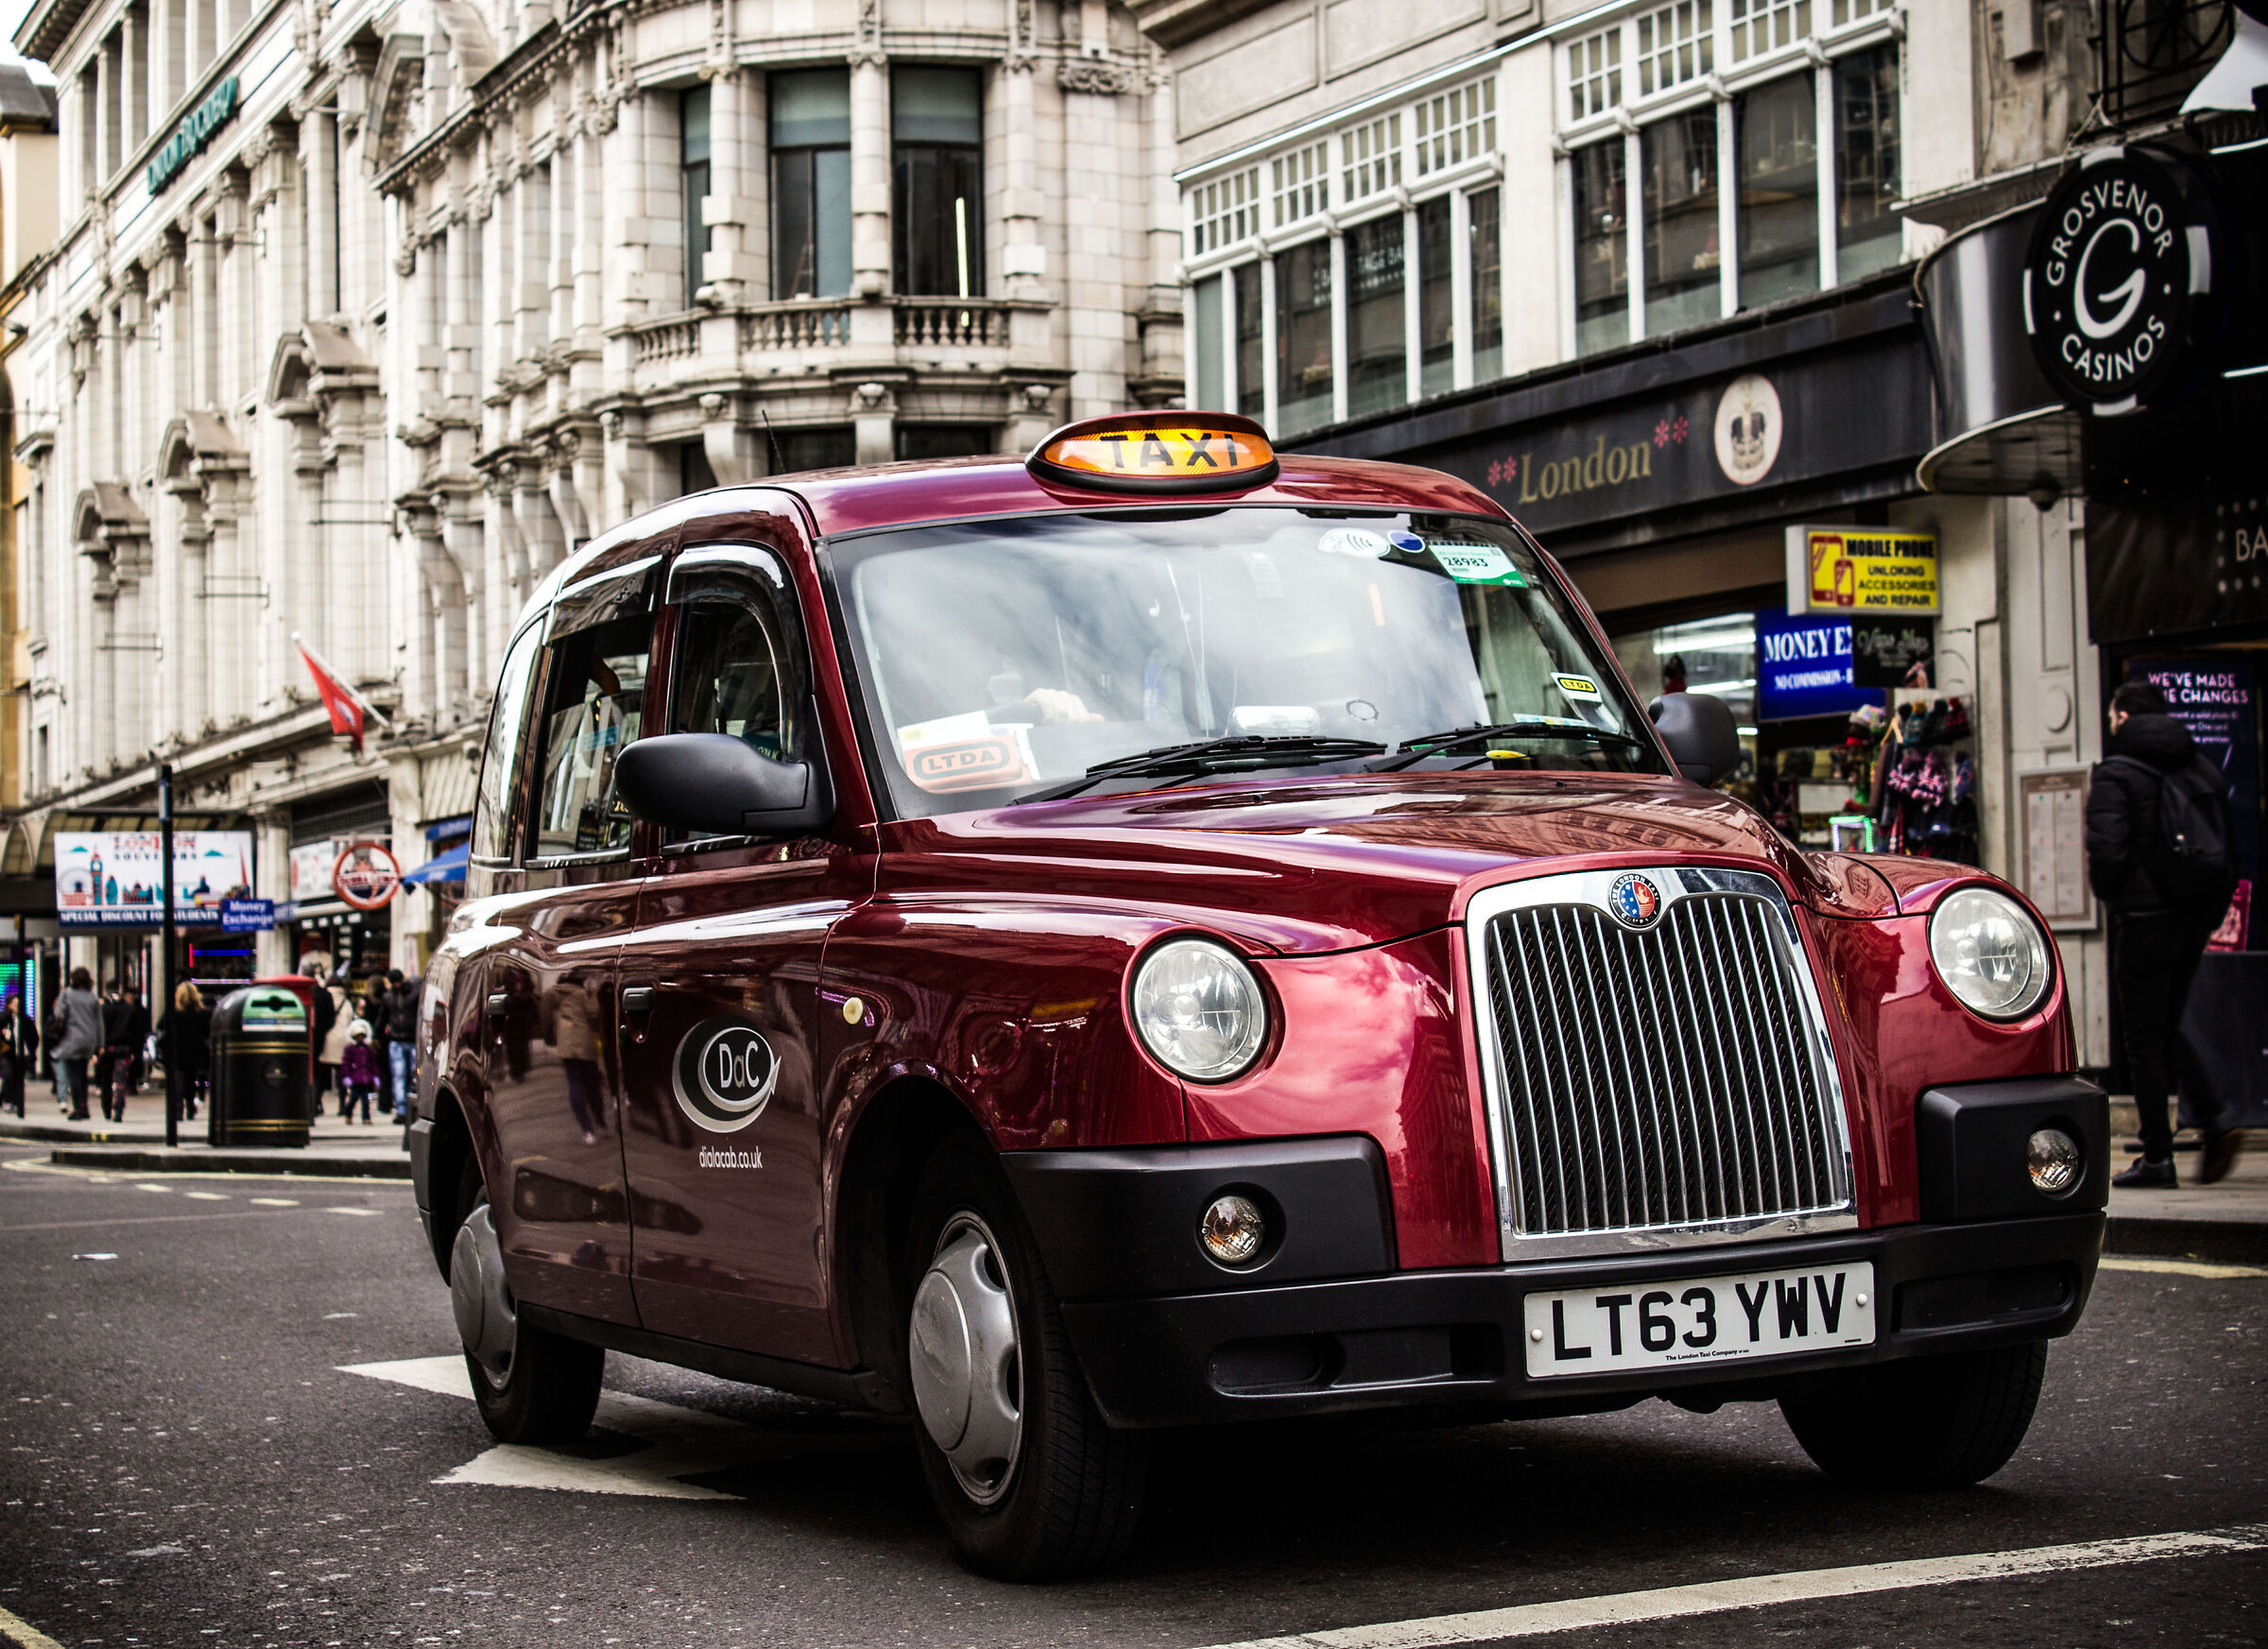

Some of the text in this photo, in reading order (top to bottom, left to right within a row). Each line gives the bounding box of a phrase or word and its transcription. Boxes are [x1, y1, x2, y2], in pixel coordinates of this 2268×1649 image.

[2046, 179, 2174, 286] GROSVENOR
[2062, 314, 2166, 382] CASINOS
[1100, 432, 1238, 468] TAXI
[1518, 433, 1652, 506] London
[1847, 539, 1935, 558] MOBILE PHONE
[1442, 556, 1489, 568] 28983
[1859, 579, 1935, 592] ACCESSORIES
[1865, 594, 1931, 606] AND REPAIR
[1764, 627, 1831, 663] MONEY
[1563, 680, 1593, 690] LTDA
[1788, 669, 1841, 689] COMMISSION
[2148, 672, 2236, 688] WE'VE MADE
[2180, 688, 2249, 704] CHANGES
[928, 749, 997, 771] LTDA
[1616, 875, 1645, 886] LONDON
[230, 901, 266, 912] Money
[60, 910, 98, 922] SPECIAL
[101, 910, 147, 922] DISCOUNT
[149, 910, 163, 921] FO
[222, 912, 274, 925] Exchange
[719, 1040, 760, 1089] DaC
[698, 1145, 764, 1169] dialacab.co.uk
[1552, 1272, 1847, 1362] LT63 YWV
[1711, 1348, 1738, 1358] Company
